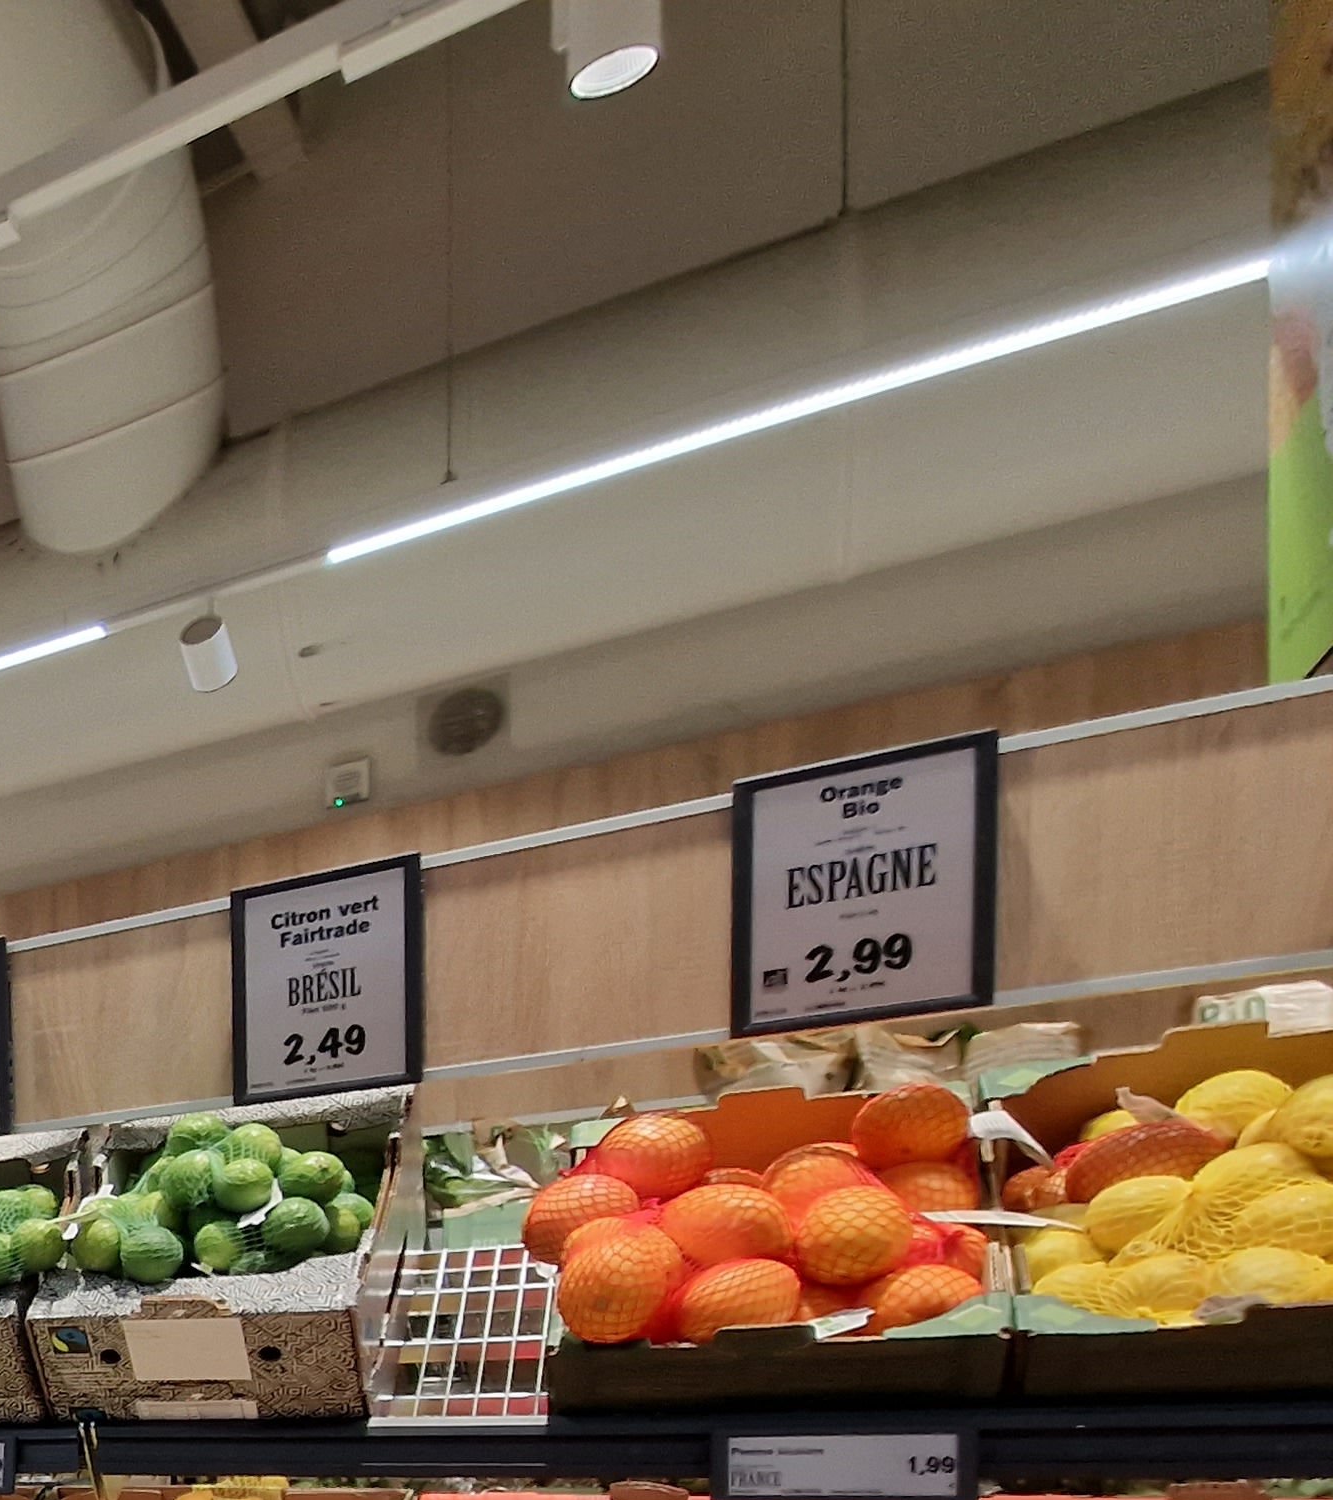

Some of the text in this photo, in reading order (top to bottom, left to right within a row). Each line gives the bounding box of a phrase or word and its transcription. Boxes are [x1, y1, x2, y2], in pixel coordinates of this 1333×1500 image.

[820, 776, 904, 803] Orange
[842, 801, 881, 820] Bio
[785, 843, 938, 910] ESPAGNE
[270, 895, 380, 930] Citron vert
[279, 918, 371, 948] Fairtrade
[804, 932, 913, 984] 2,99
[286, 966, 363, 1008] BRÉSIL
[283, 1023, 367, 1066] 2,49
[730, 1470, 782, 1488] FRANCE
[907, 1455, 956, 1476] 1,99
